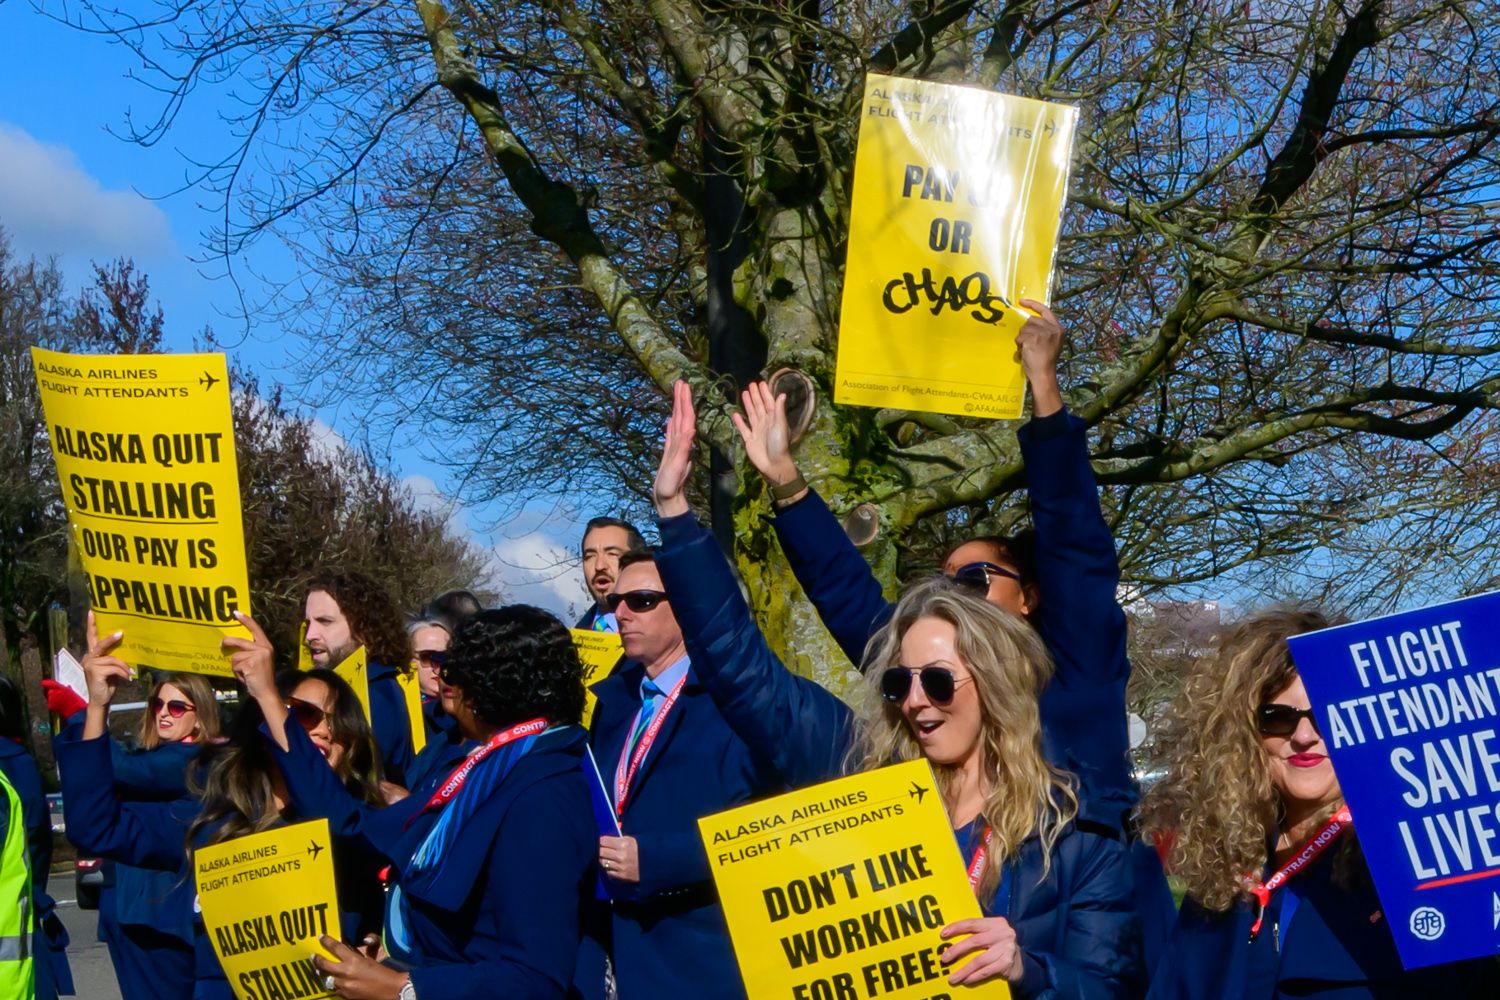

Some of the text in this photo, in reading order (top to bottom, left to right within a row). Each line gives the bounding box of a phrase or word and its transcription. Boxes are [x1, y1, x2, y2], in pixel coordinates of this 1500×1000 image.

[902, 164, 960, 202] PAY
[928, 218, 973, 254] OR
[882, 268, 1012, 325] CHAOS
[38, 362, 158, 379] ALASKA AIRLINES
[41, 380, 189, 398] FLIGHT ATTENDANTS
[842, 379, 890, 392] Association
[54, 424, 222, 467] ALASKA QUIT
[70, 473, 216, 519] STALLING
[82, 528, 218, 569] OUR PAY IS
[1349, 620, 1468, 688] FLIGHT
[648, 700, 674, 737] CONTRACT
[634, 744, 646, 764] NOW
[441, 758, 475, 797] CONTRACT
[712, 790, 869, 845] ALASKA AIRLINES
[718, 803, 904, 867] FLIGHT ATTENDANTS
[199, 845, 278, 874] ALASKA AIRLINES
[200, 859, 301, 893] FLIGHT ATTENDANTS
[1265, 822, 1341, 890] CONTRACT NOW
[762, 844, 934, 923] DON'T LIKE
[215, 903, 328, 957] ALASKA QUIT
[780, 894, 945, 970] WORKING
